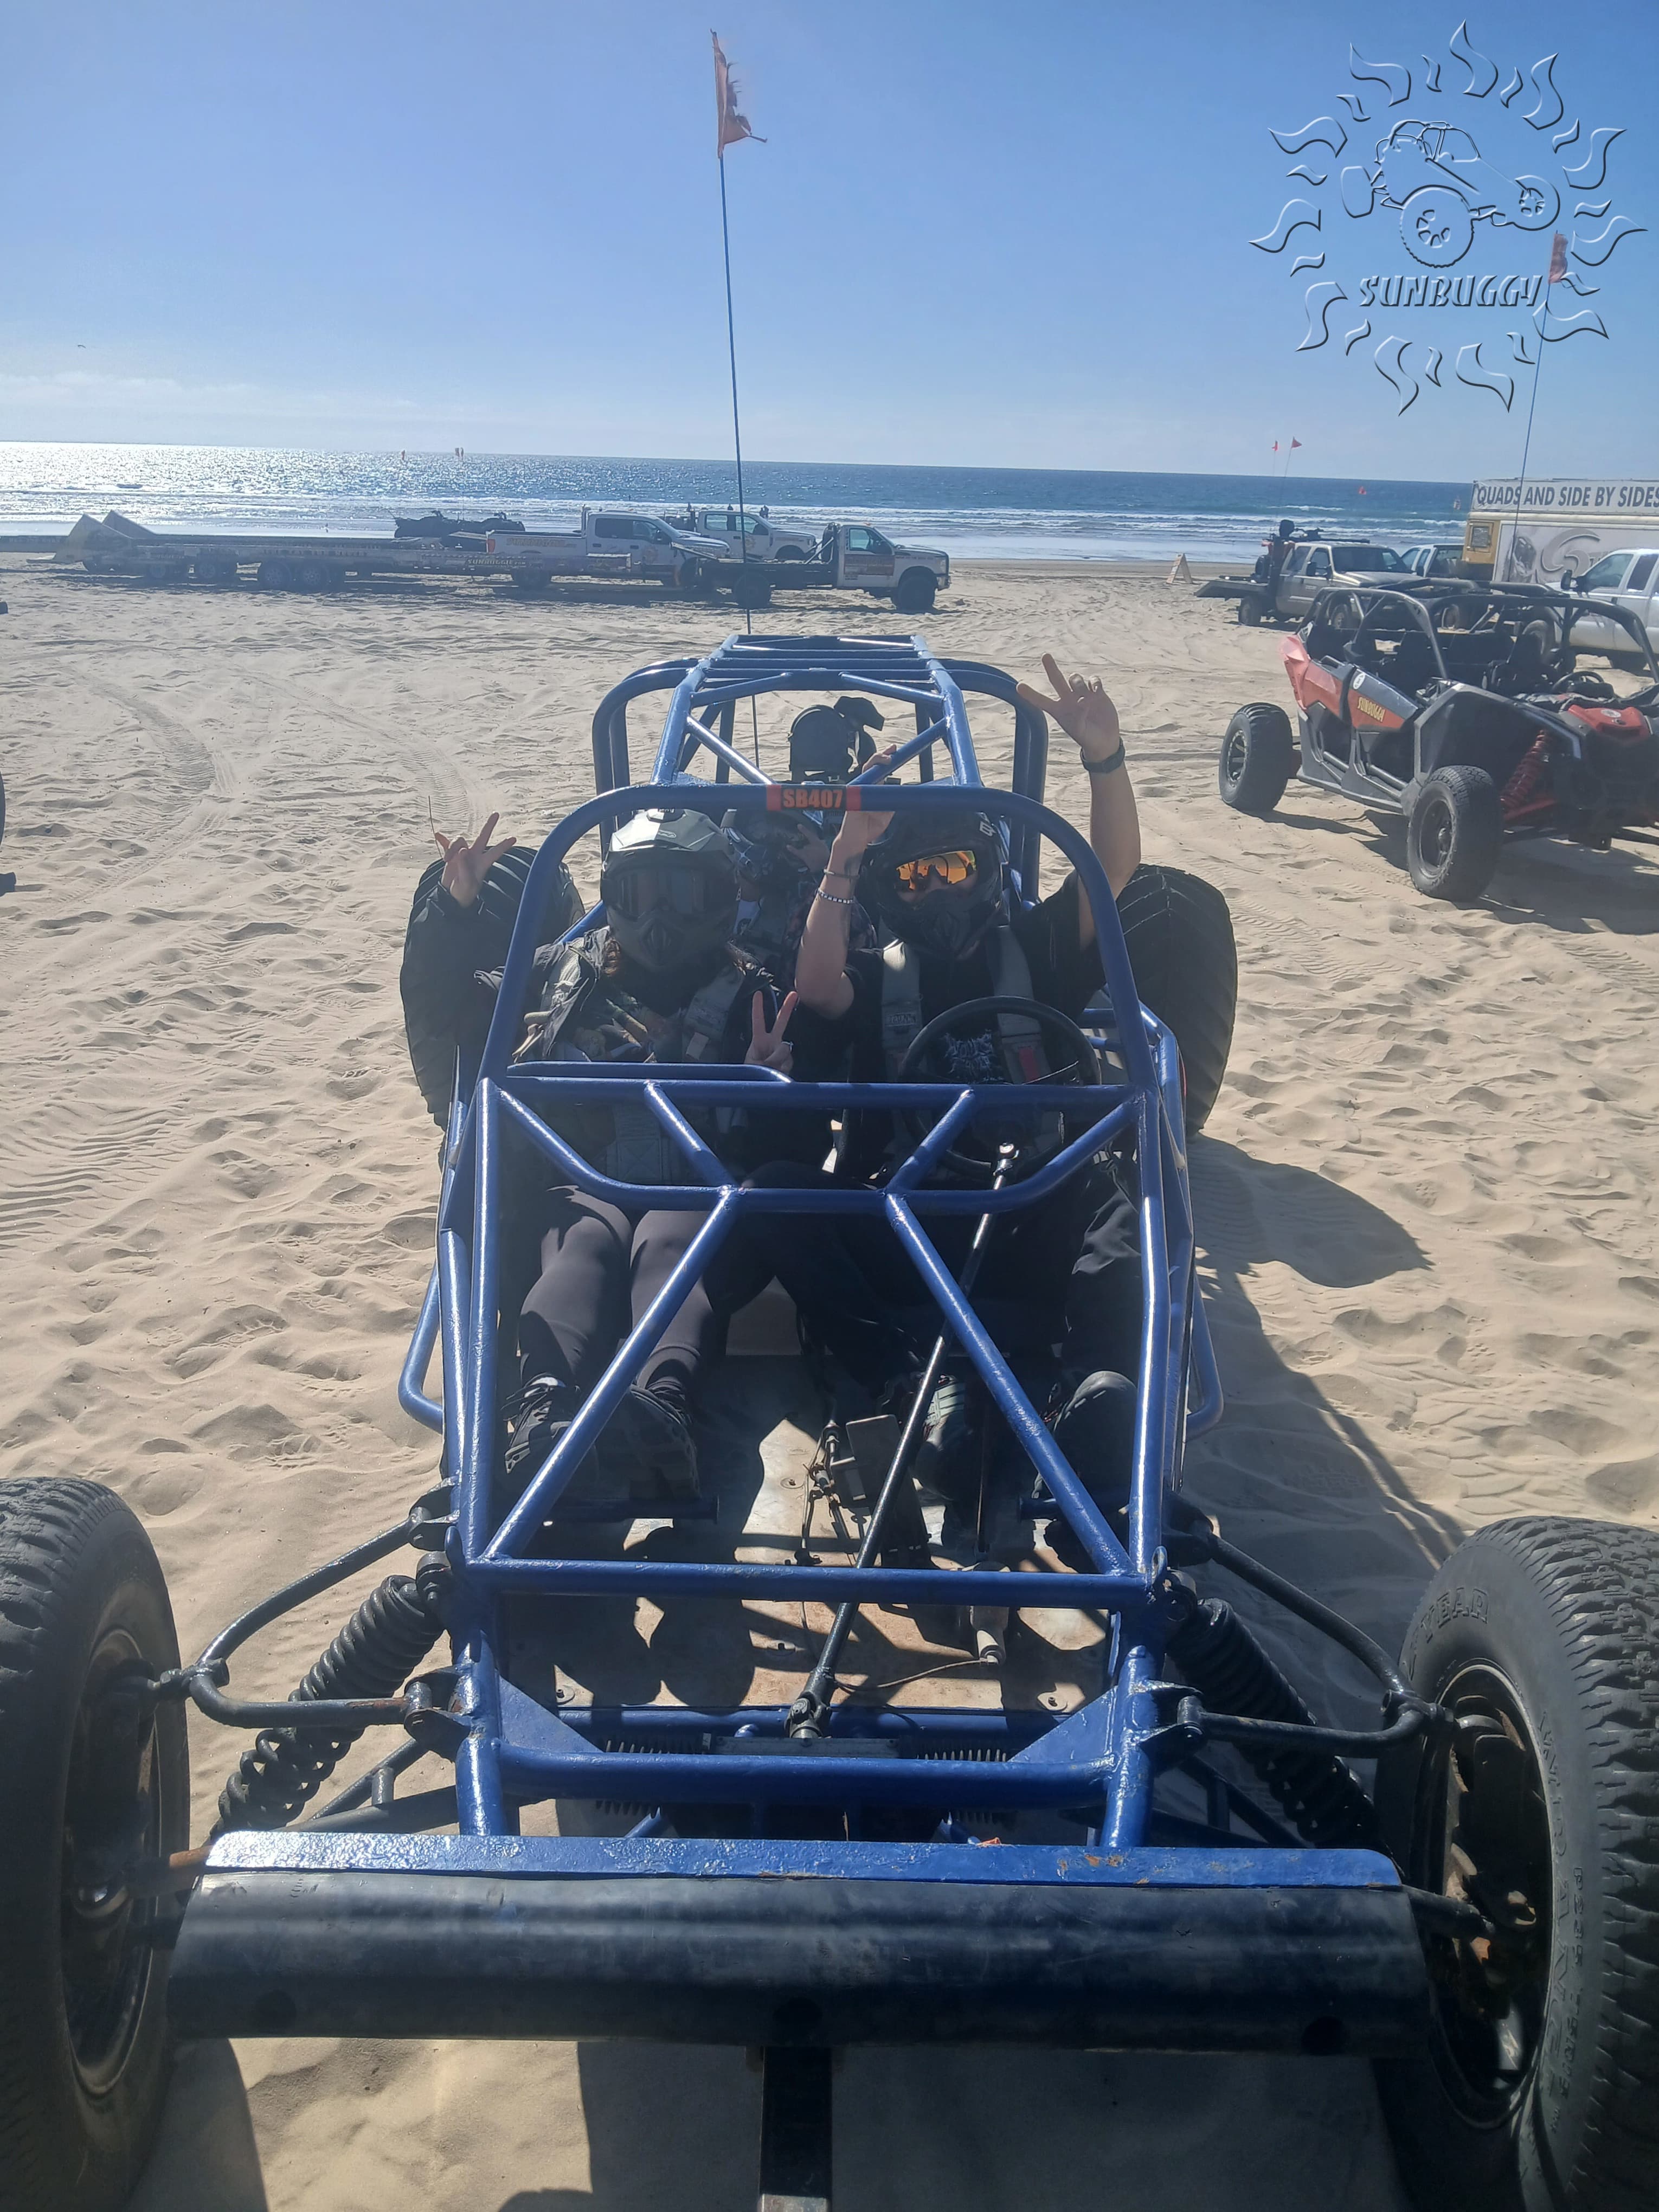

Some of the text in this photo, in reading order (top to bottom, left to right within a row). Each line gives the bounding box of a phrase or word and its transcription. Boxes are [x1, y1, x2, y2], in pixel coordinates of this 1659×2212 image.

[1477, 486, 1522, 506] QUADS
[1524, 486, 1555, 506] AND
[1559, 486, 1591, 506] SIDE
[1594, 486, 1615, 507] BY
[783, 789, 843, 808] SB407
